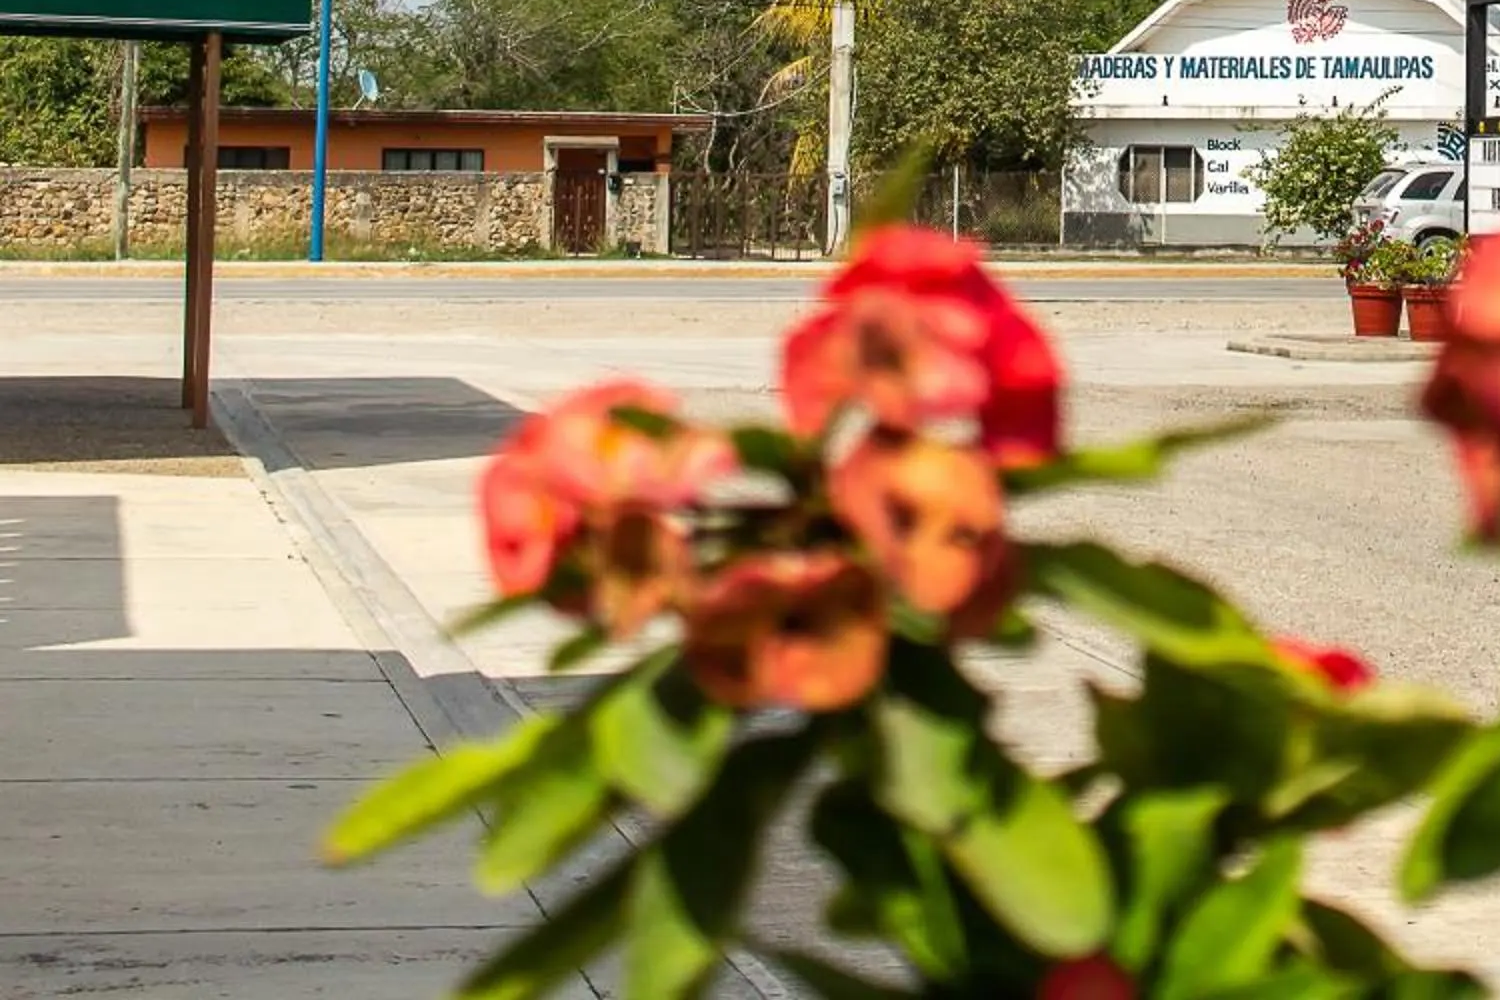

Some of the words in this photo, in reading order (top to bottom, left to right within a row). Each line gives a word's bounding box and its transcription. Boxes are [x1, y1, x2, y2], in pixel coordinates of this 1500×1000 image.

[1164, 56, 1175, 79] Y
[1179, 56, 1292, 79] MATERIALES
[1295, 56, 1316, 79] DE
[1321, 56, 1434, 79] TAMAULIPAS
[1207, 138, 1241, 151] Block
[1207, 160, 1229, 173] Cal
